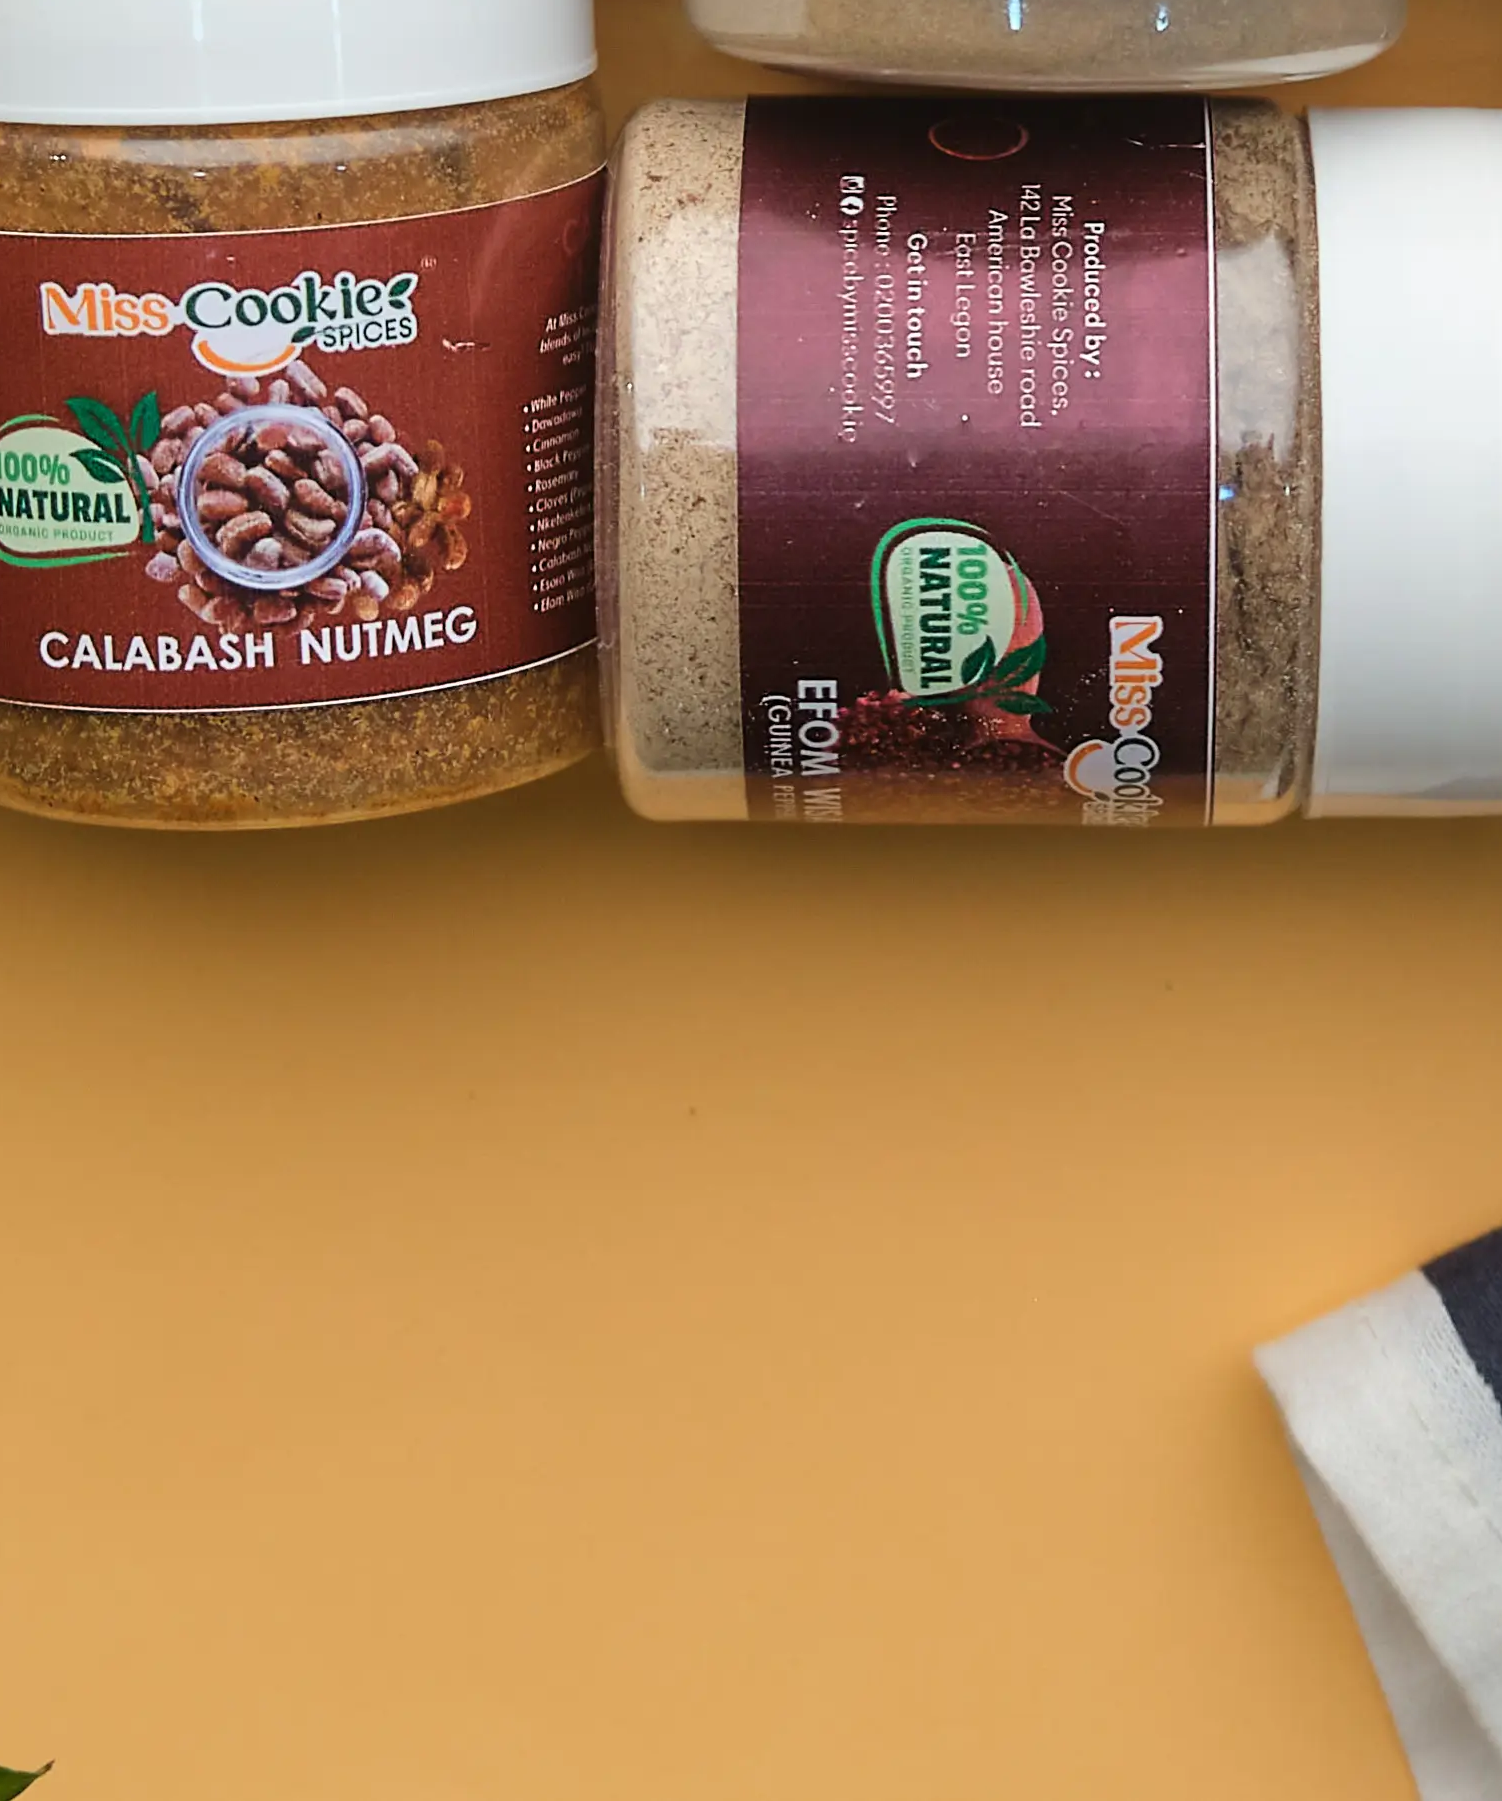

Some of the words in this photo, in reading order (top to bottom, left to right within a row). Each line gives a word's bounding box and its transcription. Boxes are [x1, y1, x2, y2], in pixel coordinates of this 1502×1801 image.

[876, 196, 897, 256] Phone
[1019, 217, 1040, 239] La
[1020, 184, 1040, 211] 142
[1051, 196, 1073, 237] Miss
[906, 233, 928, 274] Get
[955, 233, 976, 277] East
[987, 210, 1010, 314] American
[1051, 241, 1073, 322] Cookie
[1084, 222, 1106, 327] Produced
[47, 286, 170, 331] Miss
[186, 276, 382, 328] Cookie
[907, 280, 928, 299] in
[950, 285, 976, 358] Legon
[1019, 246, 1042, 361] Bawleshie
[323, 318, 412, 348] SPICES
[871, 274, 895, 424] 0200365997
[906, 307, 929, 379] touch
[987, 321, 1010, 394] house
[1079, 335, 1107, 365] by
[1019, 368, 1042, 428] road
[54, 528, 114, 542] PRODUCT
[900, 547, 915, 610] ORGANIC
[956, 545, 989, 635] 100%
[38, 631, 275, 671] CALABASH
[300, 606, 477, 666] NUTMEG
[901, 614, 916, 674] PRODUCT
[920, 547, 952, 688] NATURAL
[1114, 621, 1158, 726] Miss
[761, 694, 793, 778] (GUINEA
[796, 679, 839, 776] EFOM
[1114, 737, 1157, 823] Cooki
